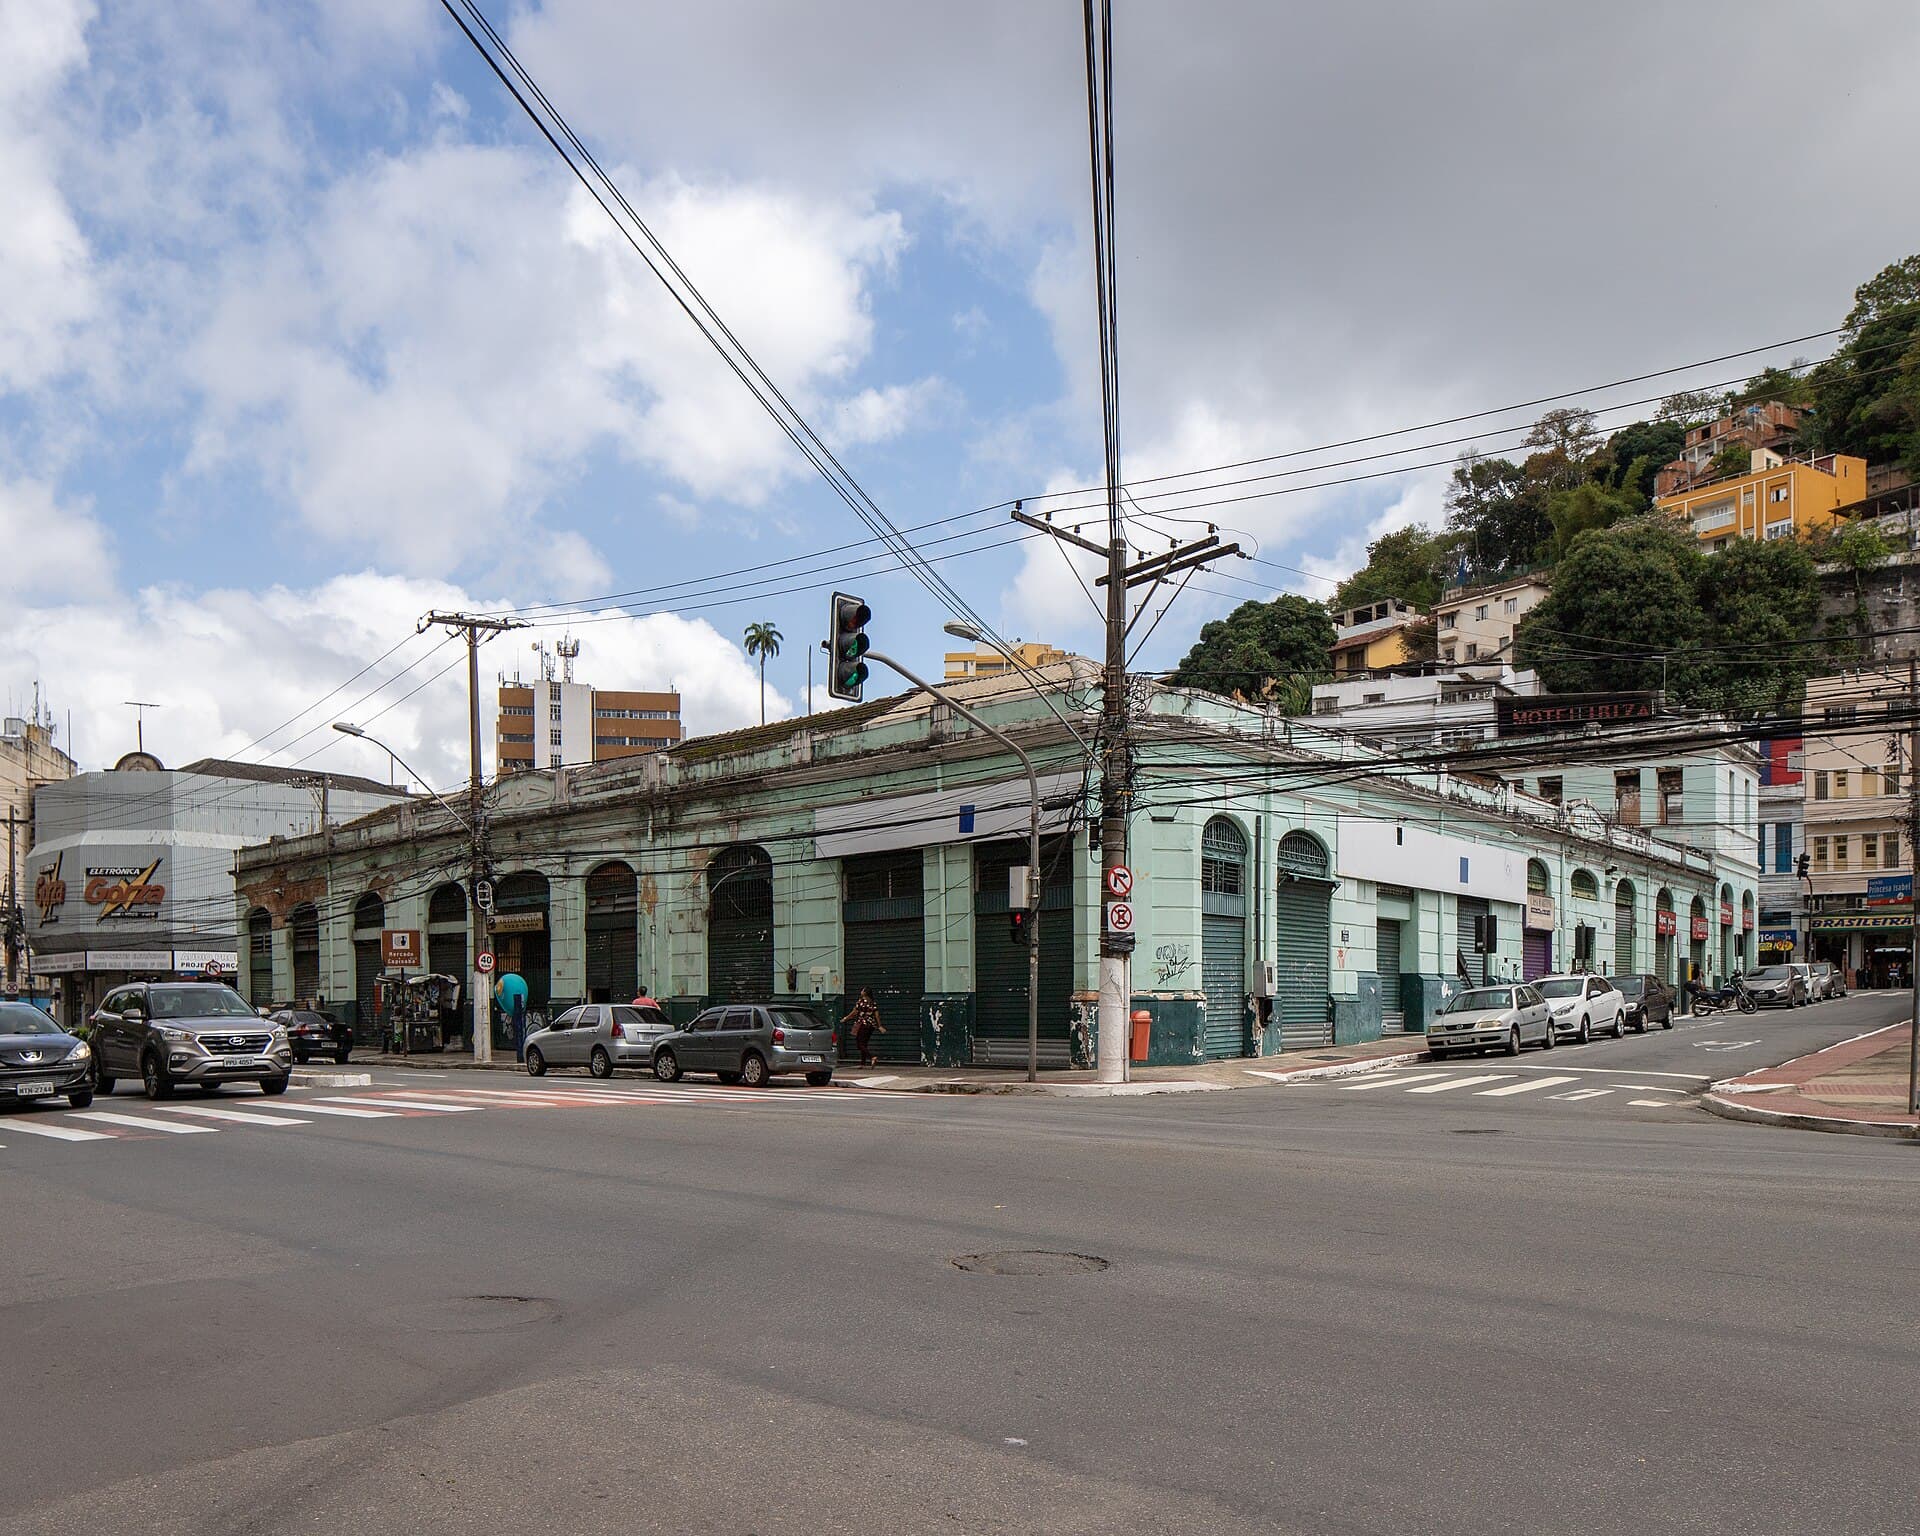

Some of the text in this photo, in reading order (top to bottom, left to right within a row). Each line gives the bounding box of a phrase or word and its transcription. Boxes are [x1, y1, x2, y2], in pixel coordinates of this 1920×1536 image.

[84, 877, 165, 906] Gorza
[1811, 917, 1912, 928] BRASILEIRA
[480, 955, 493, 964] 40
